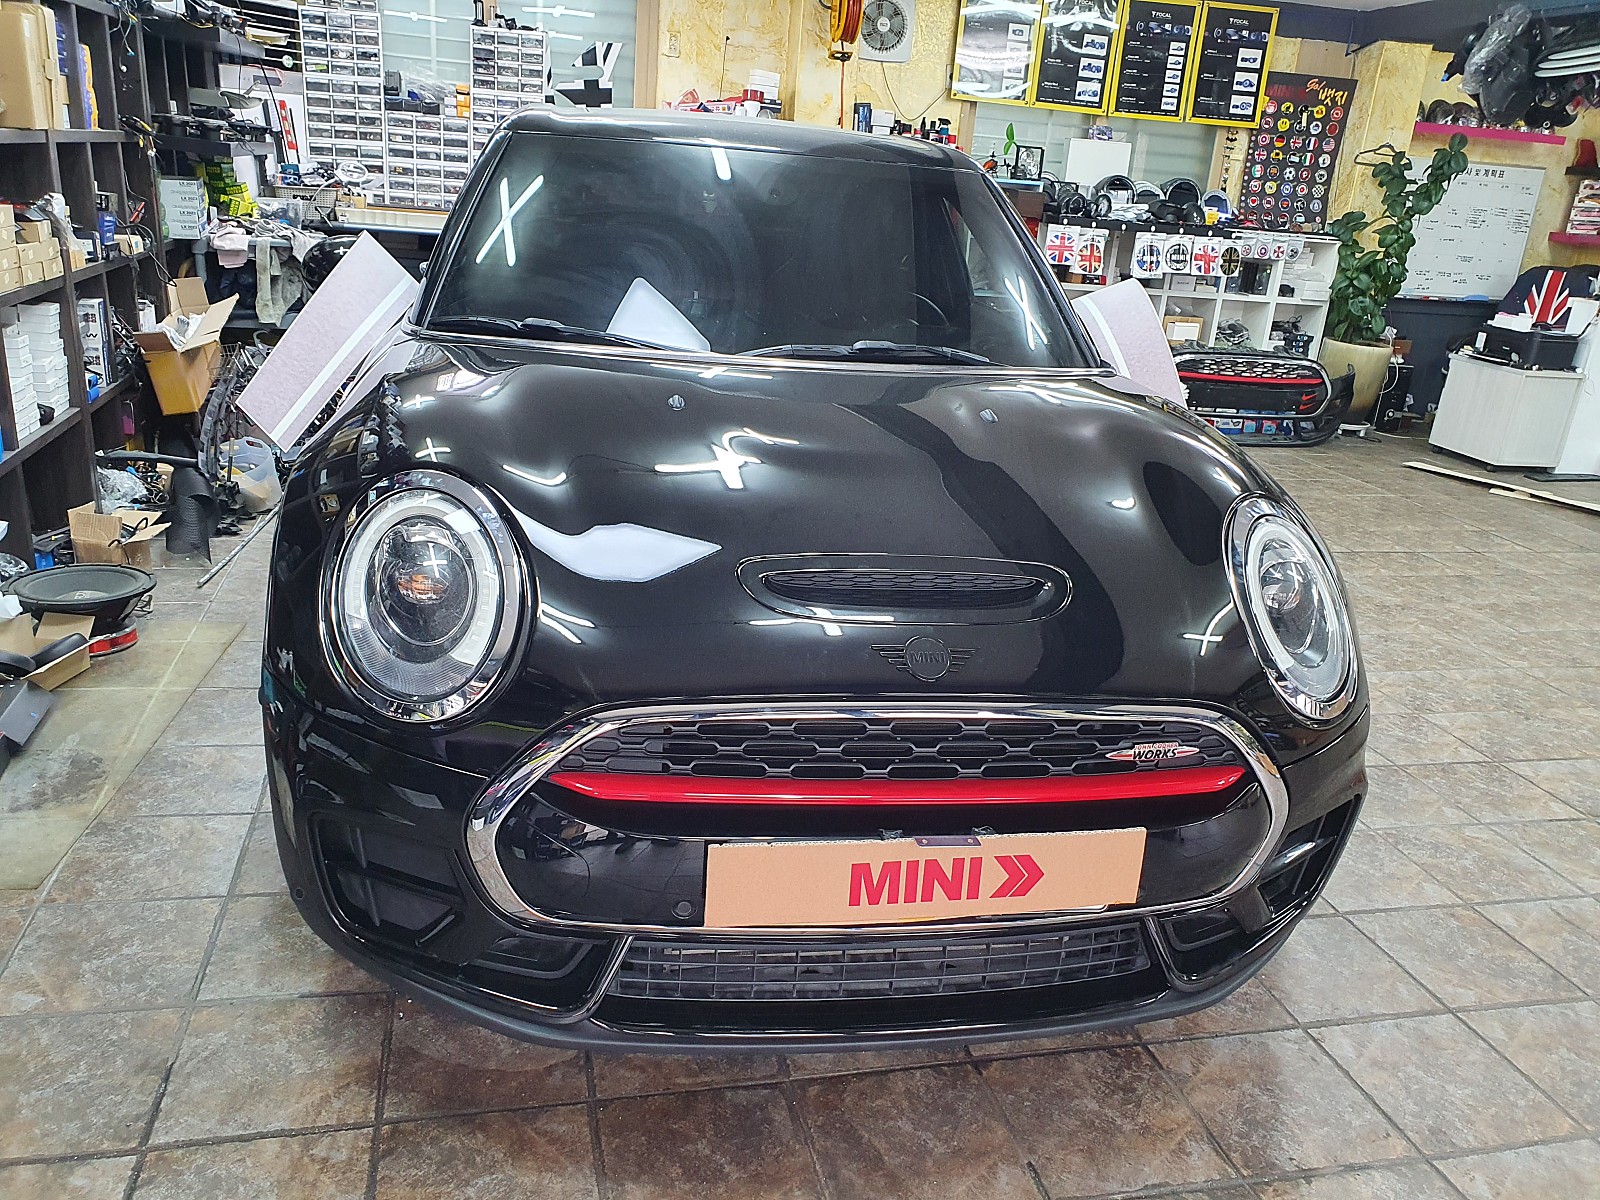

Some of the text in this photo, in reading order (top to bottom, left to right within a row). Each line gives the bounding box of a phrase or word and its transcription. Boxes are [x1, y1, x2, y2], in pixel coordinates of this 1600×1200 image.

[910, 650, 947, 664] MINI
[1132, 748, 1178, 760] WORKS
[848, 856, 983, 907] MINI
